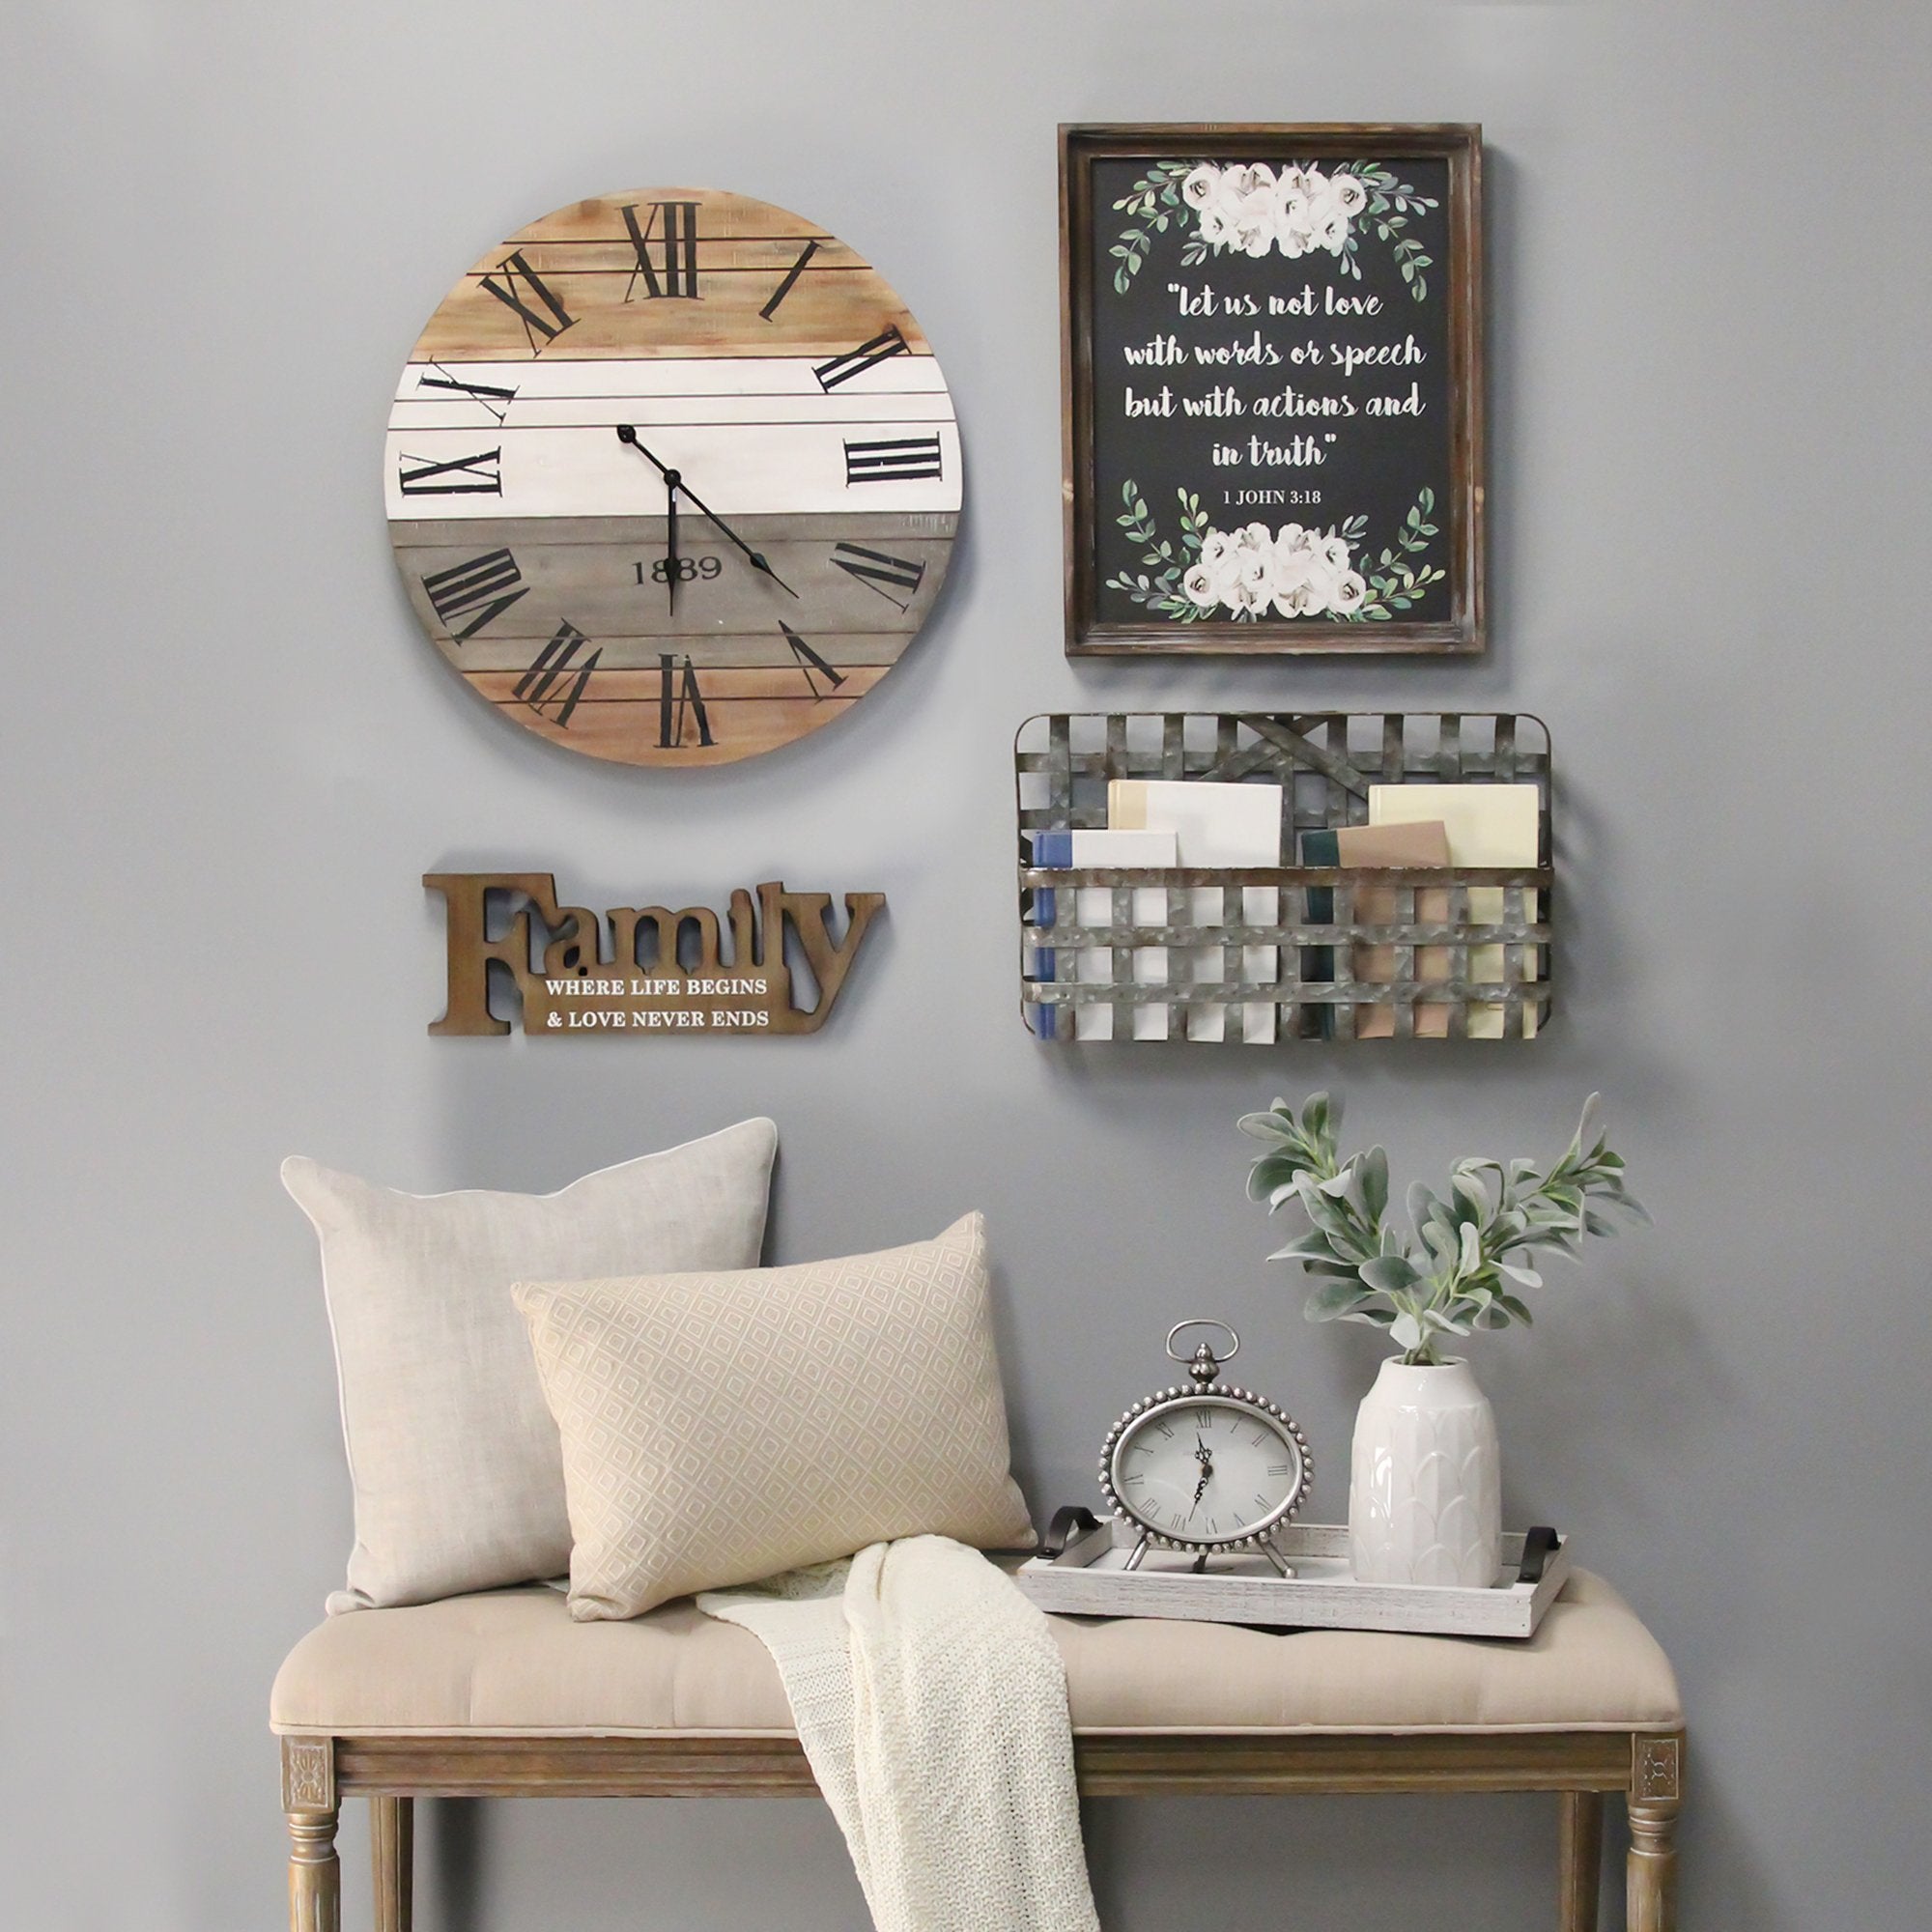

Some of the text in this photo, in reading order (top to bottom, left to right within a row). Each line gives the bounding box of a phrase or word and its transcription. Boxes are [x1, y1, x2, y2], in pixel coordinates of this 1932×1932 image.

[616, 201, 705, 304] XII
[759, 239, 821, 323] I
[477, 247, 582, 358] XI
[1223, 294, 1262, 317] us
[1268, 284, 1320, 317] not
[1324, 284, 1384, 317] love
[811, 325, 912, 394] II
[1123, 329, 1428, 377] with words or speech
[416, 355, 520, 426] X
[1124, 382, 1427, 418] but with actions and
[398, 445, 503, 498] IX
[843, 431, 943, 489] III
[1211, 442, 1243, 467] in
[1223, 489, 1322, 506] 1 JOHN 3:18
[421, 548, 530, 646] VIII
[632, 555, 723, 586] 1889
[830, 543, 925, 613] IV
[512, 617, 603, 729] VII
[778, 619, 848, 705] V
[653, 653, 719, 749] VI
[422, 873, 886, 1037] Family
[545, 979, 768, 996] WHERE LIFE BEGINS
[547, 1010, 770, 1028] & LOVE NEVER ENDS
[1195, 1409, 1212, 1430] XII
[1266, 1464, 1289, 1477] III
